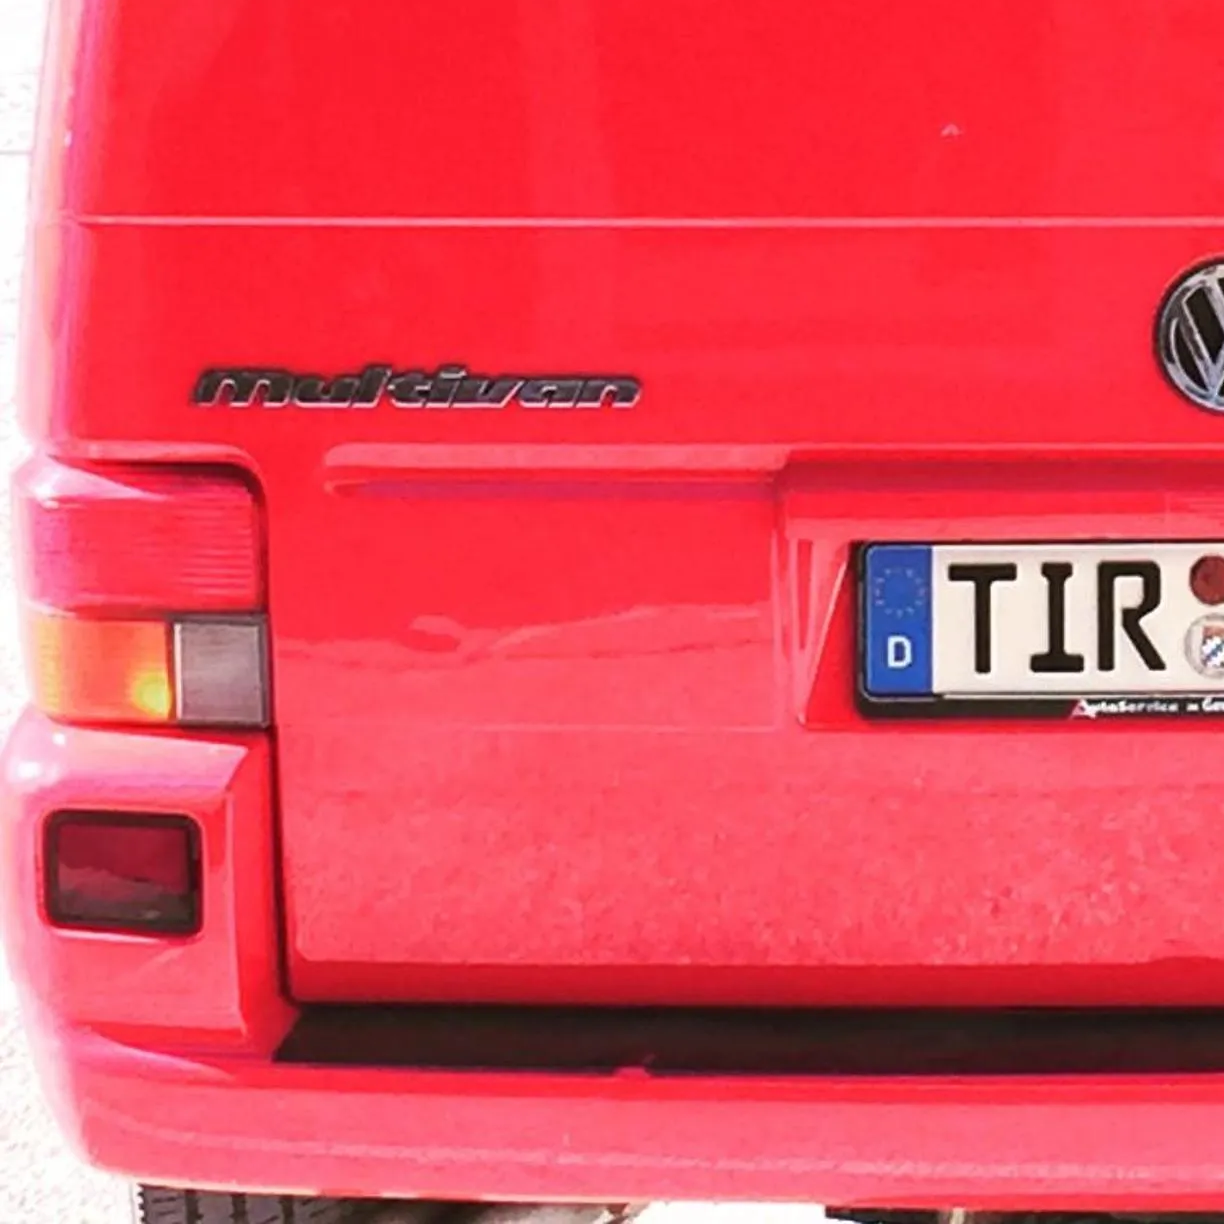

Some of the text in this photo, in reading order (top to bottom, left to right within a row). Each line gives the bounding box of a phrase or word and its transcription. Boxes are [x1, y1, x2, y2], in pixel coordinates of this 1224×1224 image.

[191, 364, 642, 410] multivan
[947, 561, 1167, 673] TIR
[887, 635, 912, 670] D
